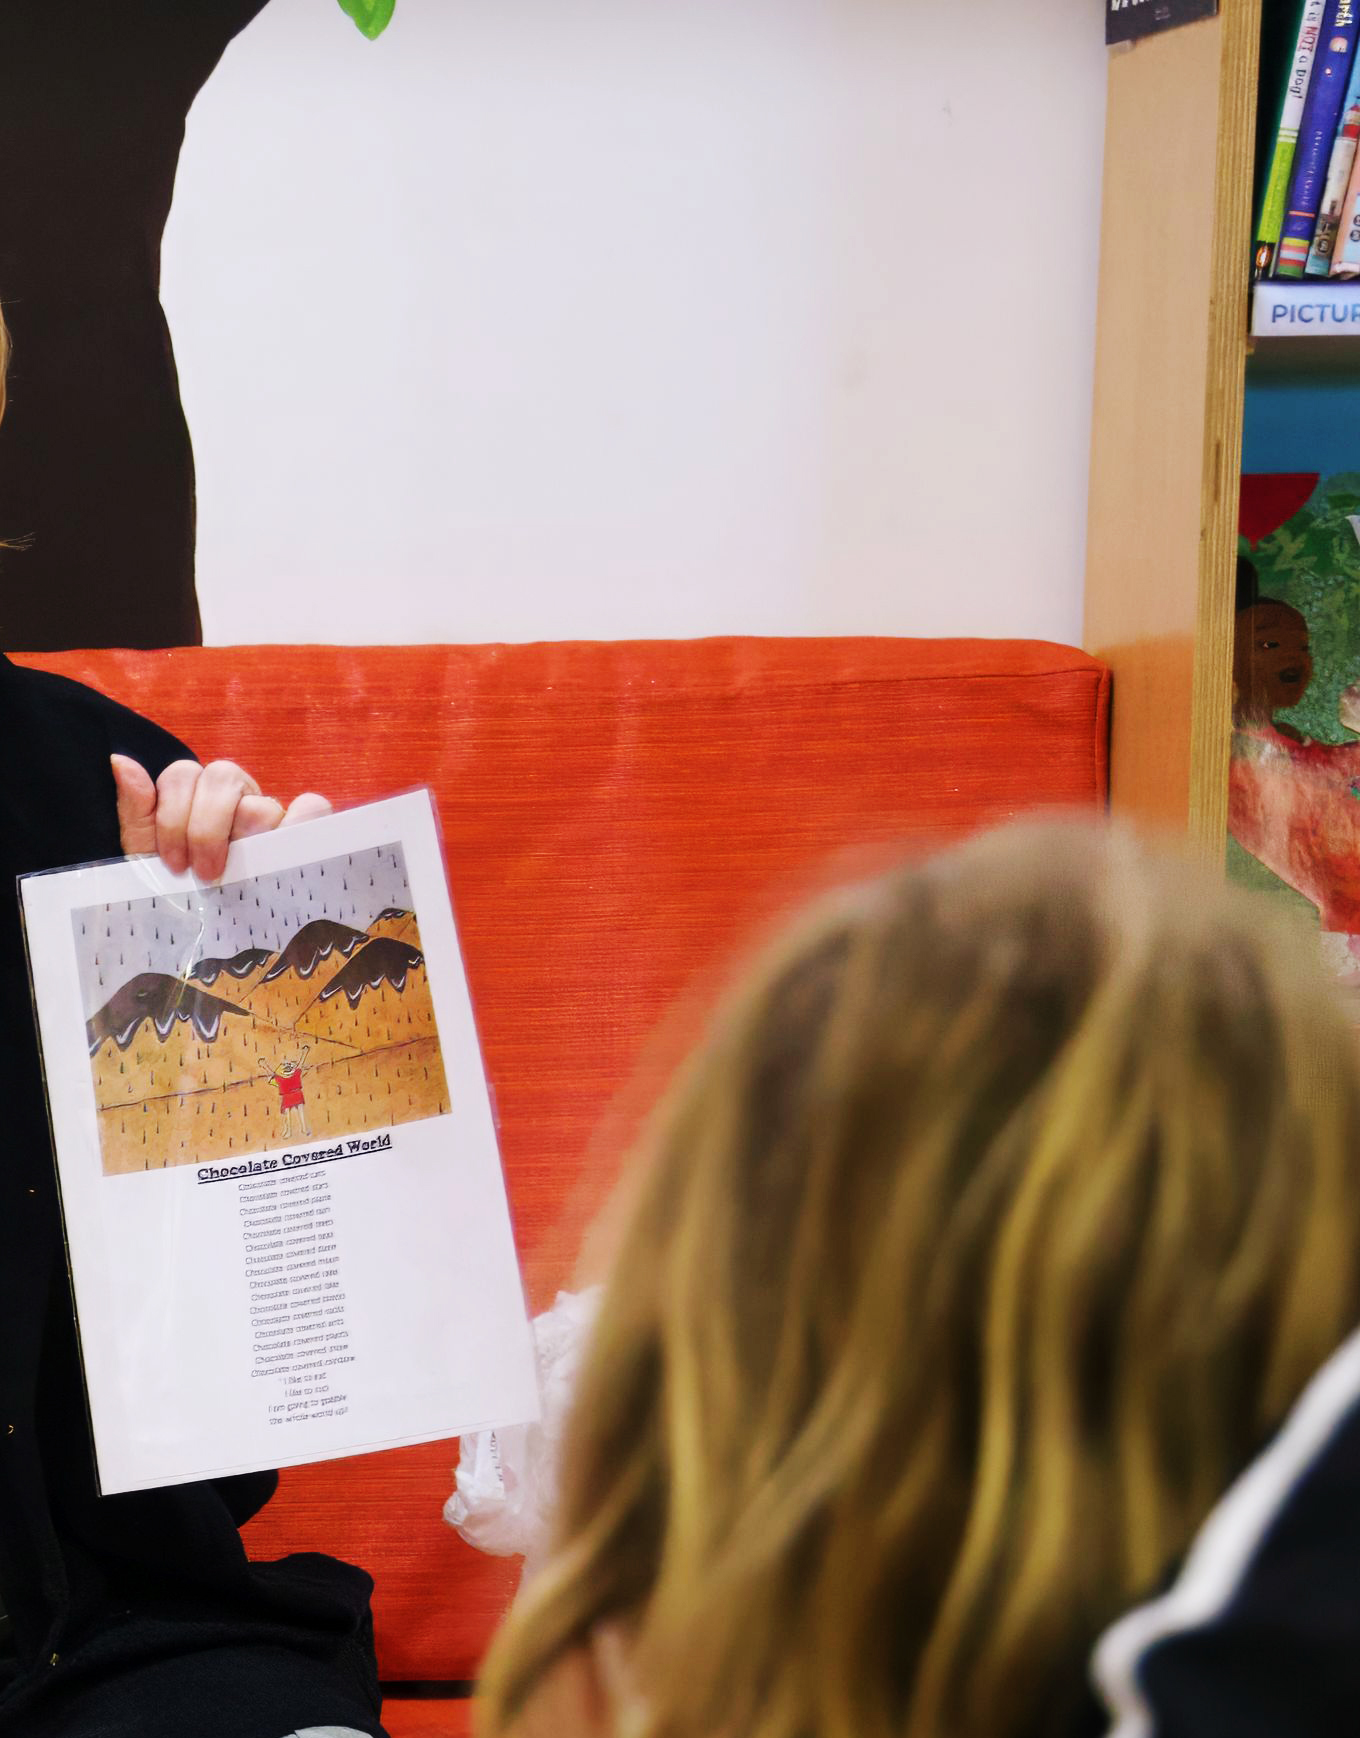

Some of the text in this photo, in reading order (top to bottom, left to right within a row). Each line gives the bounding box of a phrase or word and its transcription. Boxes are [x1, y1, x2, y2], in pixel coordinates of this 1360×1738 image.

[1299, 26, 1318, 52] NOT
[1272, 304, 1360, 323] PICTUR
[197, 1134, 391, 1181] Chocolate Covered World
